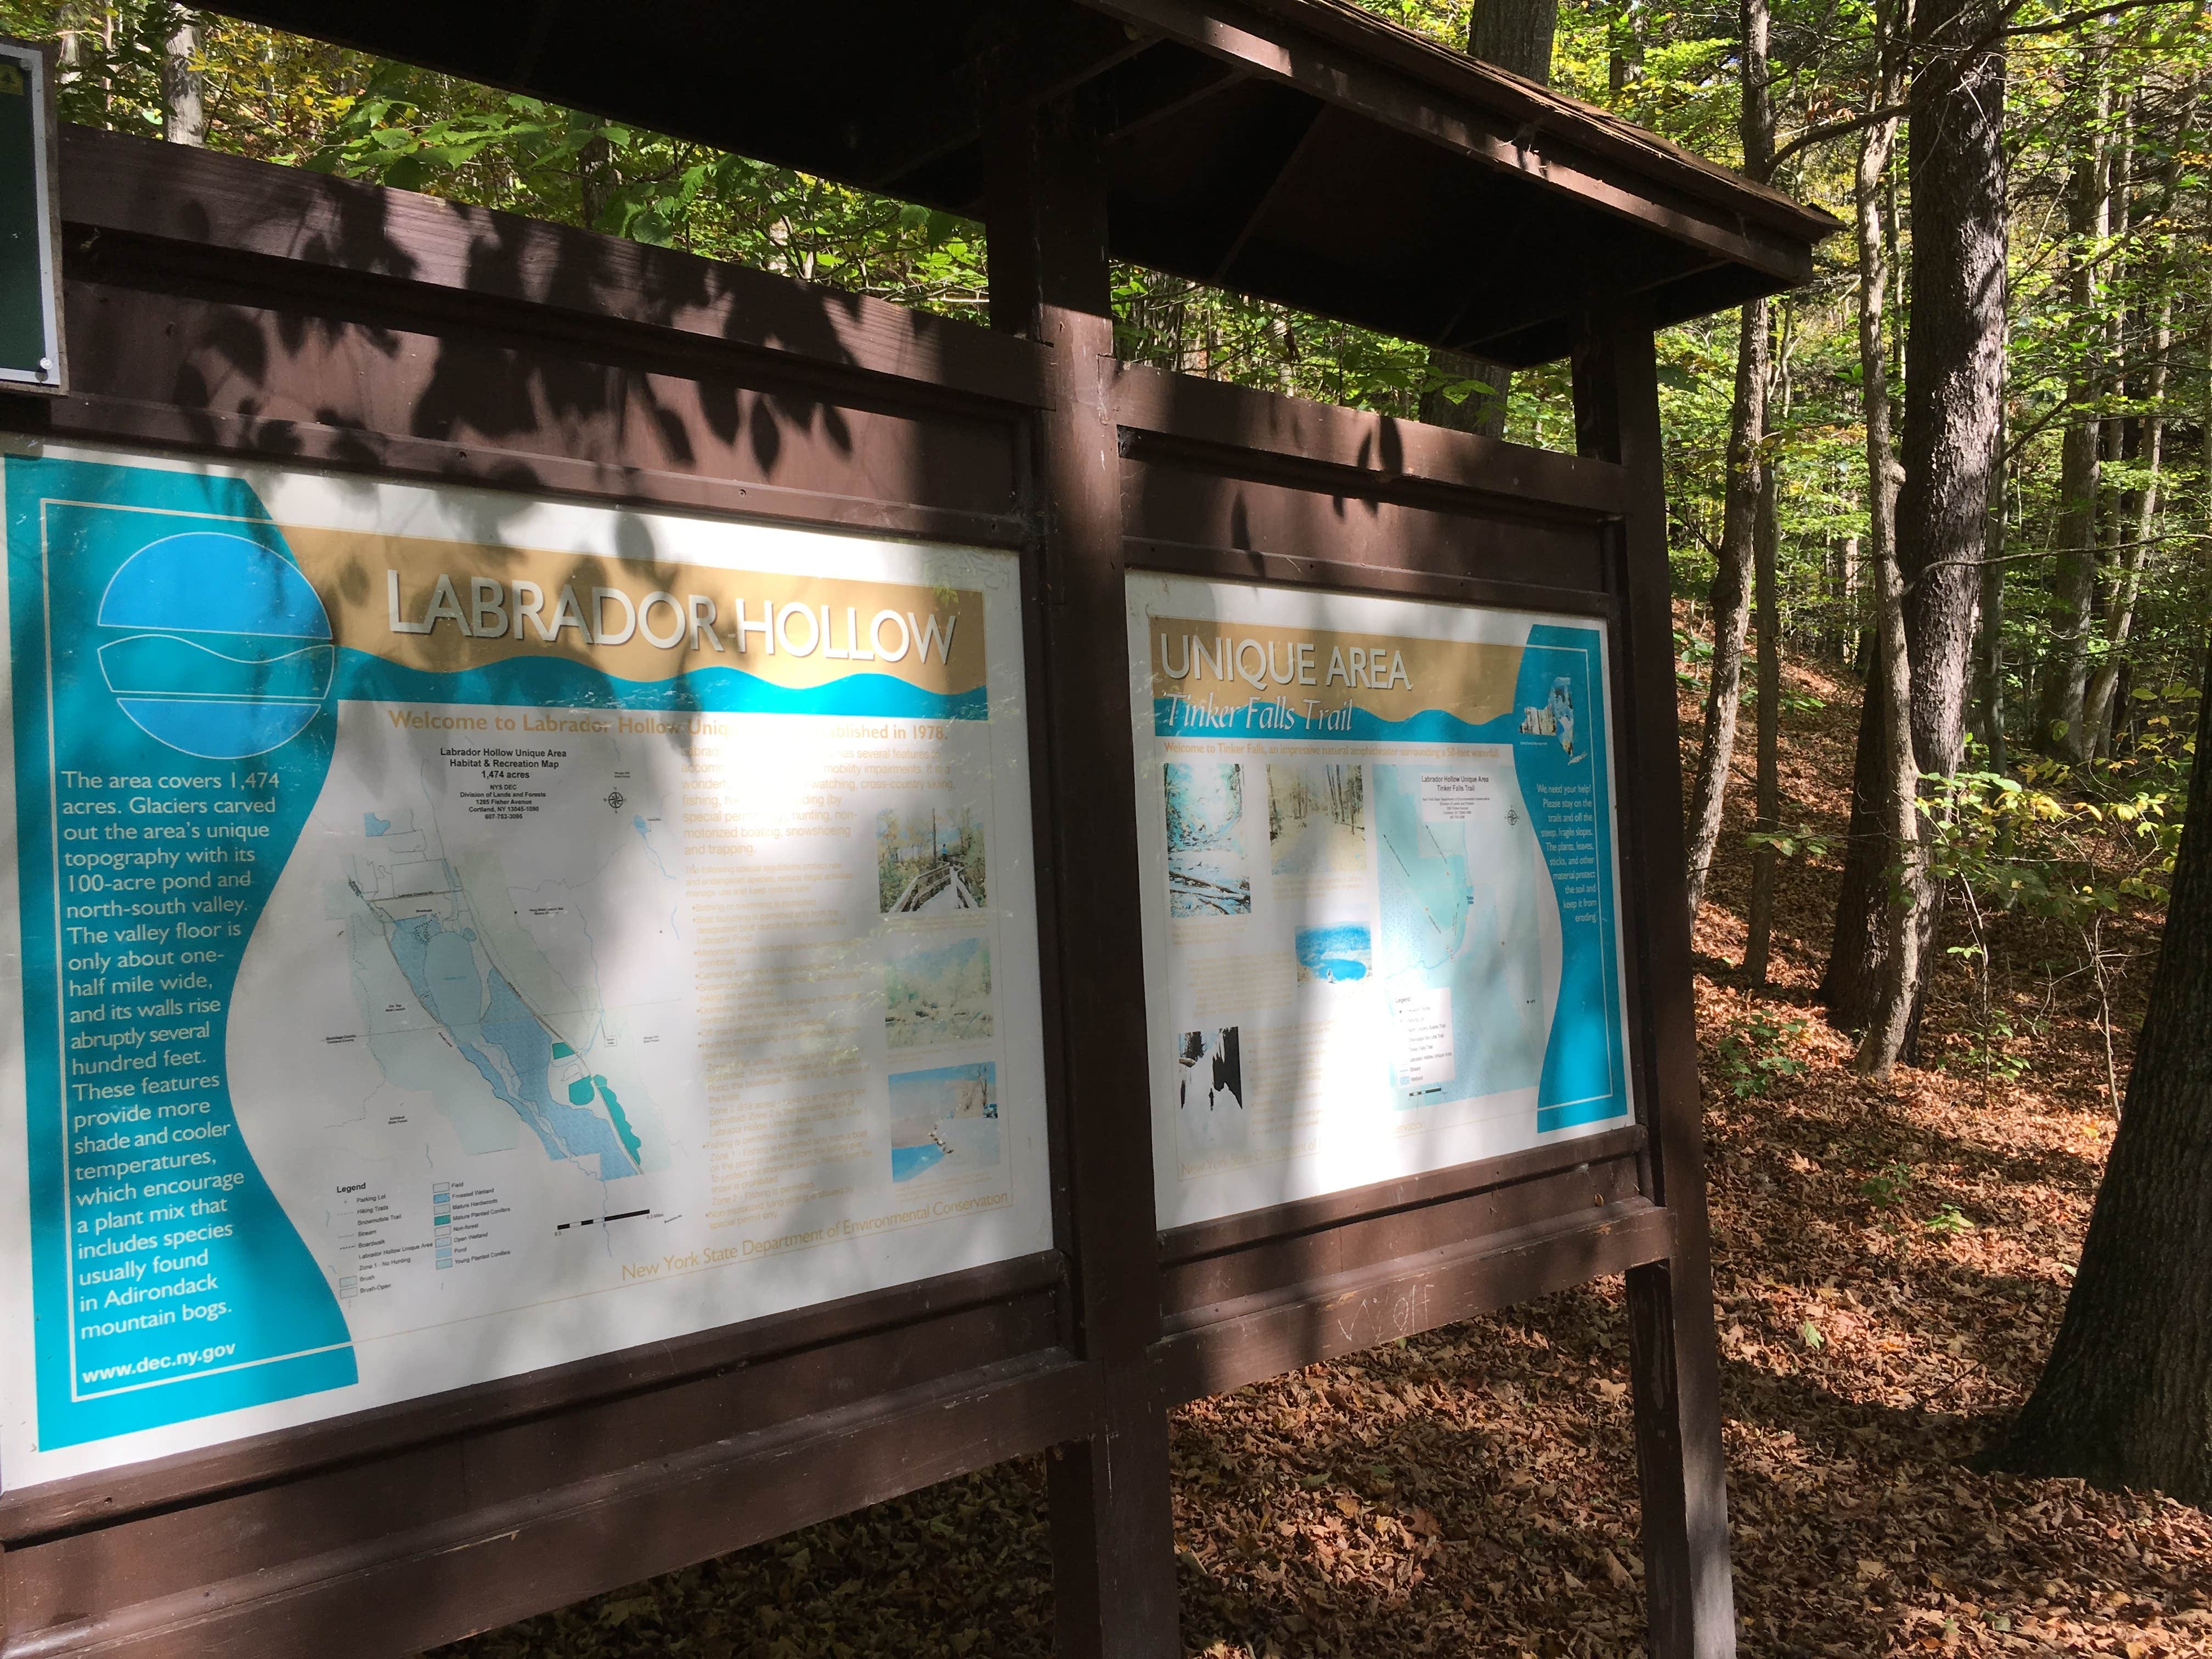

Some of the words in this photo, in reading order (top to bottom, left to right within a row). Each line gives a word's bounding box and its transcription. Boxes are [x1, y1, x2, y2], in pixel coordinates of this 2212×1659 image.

[387, 569, 724, 652] LABRADOR
[736, 597, 956, 664] HOLLOW
[1160, 633, 1317, 690] UNIQUE
[1325, 646, 1412, 691] AREA
[1164, 692, 1242, 729] Tinker
[1246, 696, 1295, 731] Falls
[1302, 698, 1353, 731] Trail
[389, 710, 488, 731] Welcome
[495, 711, 515, 731] to
[523, 712, 611, 733] Labrador
[619, 715, 681, 735] Hollow
[894, 725, 906, 739] in
[913, 725, 947, 740] 1978.
[441, 748, 481, 756] Labrador
[516, 749, 545, 758] Unique
[857, 749, 890, 759] several
[1164, 743, 1204, 753] Welcome
[1218, 743, 1244, 754] Tinker
[1246, 744, 1266, 755] Falls,
[1268, 746, 1278, 754] an
[1280, 744, 1321, 757] impressive
[1323, 746, 1348, 755] natural
[1351, 747, 1398, 757] amphitheater
[482, 771, 504, 779] 1,474
[541, 760, 558, 769] Map
[61, 770, 102, 788] The
[110, 776, 152, 788] area
[159, 775, 221, 788] covers
[231, 772, 279, 790] 1,474
[1537, 784, 1547, 793] We
[1549, 784, 1562, 793] need
[1564, 786, 1576, 795] your
[63, 801, 122, 814] acres.
[129, 797, 207, 814] Glaciers
[214, 797, 275, 813] carved
[684, 794, 721, 808] fishing,
[1543, 799, 1560, 808] Please
[1562, 800, 1573, 809] stay
[1583, 799, 1592, 807] the
[684, 811, 721, 825] special
[1564, 813, 1573, 822] and
[1583, 813, 1592, 821] the
[64, 826, 98, 840] out
[104, 823, 137, 839] the
[144, 821, 200, 839] area's
[207, 822, 269, 842] unique
[685, 827, 737, 839] motorized
[741, 827, 783, 839] boating,
[786, 826, 850, 838] snowshoeing
[685, 844, 704, 855] and
[709, 843, 756, 856] trapping.
[1545, 842, 1556, 851] The
[65, 847, 180, 871] topography
[186, 848, 228, 864] with
[235, 848, 255, 862] its
[1568, 856, 1578, 865] and
[1579, 856, 1594, 864] other
[69, 874, 155, 892] 100-acre
[163, 871, 211, 893] pond
[218, 871, 251, 887] and
[1553, 871, 1575, 879] material
[1576, 872, 1595, 881] protect
[1565, 885, 1575, 894] the
[1576, 884, 1584, 893] soil
[1586, 884, 1596, 892] and
[67, 898, 185, 918] north-south
[192, 896, 247, 915] valley.
[1564, 900, 1576, 910] keep
[1583, 899, 1596, 907] from
[67, 927, 108, 944] The
[115, 924, 170, 945] valley
[176, 922, 221, 939] floor
[228, 921, 241, 936] is
[69, 952, 111, 974] only
[117, 951, 174, 968] about
[181, 950, 224, 963] one-
[70, 978, 106, 996] half
[112, 975, 154, 994] mile
[160, 972, 212, 990] wide,
[70, 1004, 104, 1023] and
[111, 1005, 132, 1019] its
[138, 999, 183, 1017] walls
[189, 998, 221, 1013] rise
[71, 1028, 145, 1051] abruptly
[150, 1021, 210, 1043] several
[72, 1051, 156, 1075] hundred
[163, 1049, 206, 1066] feet.
[72, 1083, 135, 1101] These
[142, 1075, 219, 1094] features
[75, 1104, 151, 1133] provide
[158, 1101, 210, 1118] more
[75, 1133, 130, 1155] shade
[134, 1127, 167, 1147] and
[173, 1121, 230, 1142] cooler
[75, 1151, 216, 1181] temperatures,
[76, 1183, 136, 1206] which
[144, 1172, 244, 1197] encourage
[337, 1182, 366, 1193] Legend
[77, 1220, 88, 1233] a
[96, 1211, 144, 1235] plant
[150, 1204, 184, 1222] mix
[191, 1198, 228, 1216] that
[79, 1234, 157, 1260] includes
[164, 1223, 233, 1249] species
[622, 1263, 659, 1281] New
[664, 1251, 699, 1271] York
[704, 1248, 737, 1264] State
[742, 1229, 823, 1257] Department
[827, 1221, 839, 1238] of
[843, 1206, 929, 1234] Environmental
[933, 1193, 1007, 1216] Conservation
[80, 1261, 146, 1286] usually
[153, 1249, 208, 1273] found
[80, 1296, 97, 1312] in
[104, 1273, 218, 1308] Adirondack
[81, 1310, 175, 1339] mountain
[183, 1301, 232, 1321] bogs.
[83, 1344, 235, 1383] www.dec.ny.gov
